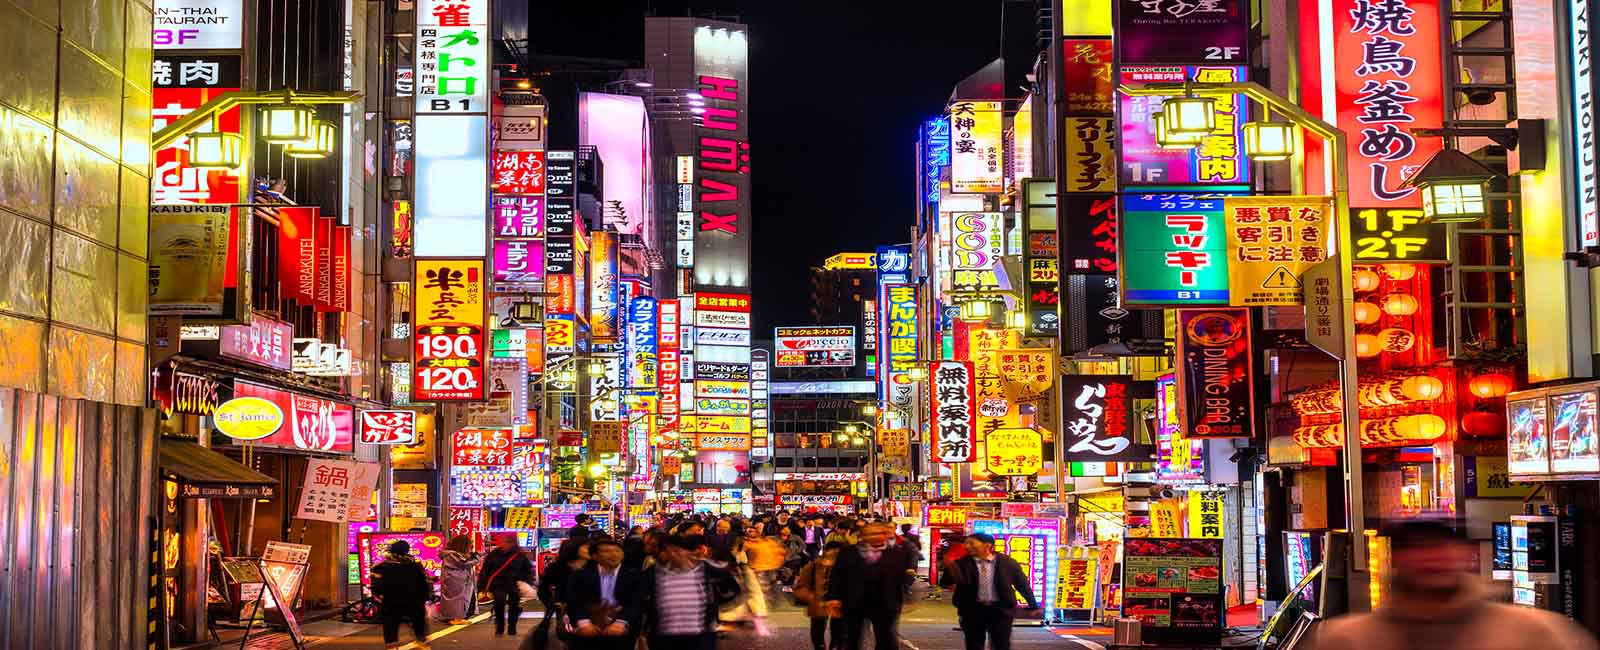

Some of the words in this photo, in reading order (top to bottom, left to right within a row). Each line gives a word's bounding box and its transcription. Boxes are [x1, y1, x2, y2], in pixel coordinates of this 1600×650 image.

[153, 29, 200, 45] 3F
[1204, 46, 1240, 60] 2F
[431, 99, 471, 111] B1
[1350, 0, 1418, 200] 焼鳥釜めし
[955, 102, 976, 153] 天神の宴
[1580, 92, 1594, 204] HONJIN
[496, 153, 543, 170] 湖南
[1128, 162, 1163, 182] 1F
[500, 207, 518, 236] ルーム
[521, 197, 538, 237] レンタル
[1235, 206, 1321, 223] 悪質な
[1357, 209, 1424, 232] 1F
[1235, 226, 1321, 243] 客引き
[506, 242, 527, 271] エデン
[1166, 215, 1211, 286] ラッキー
[1238, 246, 1325, 263] に注意
[1357, 237, 1428, 259] 2F
[299, 238, 314, 296] ANRAKUTEI
[318, 247, 331, 304] ANRAKUTEI
[335, 255, 347, 309] ANRAKUTEI
[1177, 291, 1202, 299] B1
[635, 300, 653, 341] カラオケ
[889, 286, 917, 372] まんが喫茶
[698, 364, 749, 373] ビリヤード&ダーツ
[1203, 347, 1229, 394] DINING
[937, 367, 969, 458] 無料案内所
[1206, 398, 1231, 423] BAR
[456, 430, 510, 448] 湖南
[313, 465, 349, 489] 鍋
[929, 508, 966, 524] 案内所
